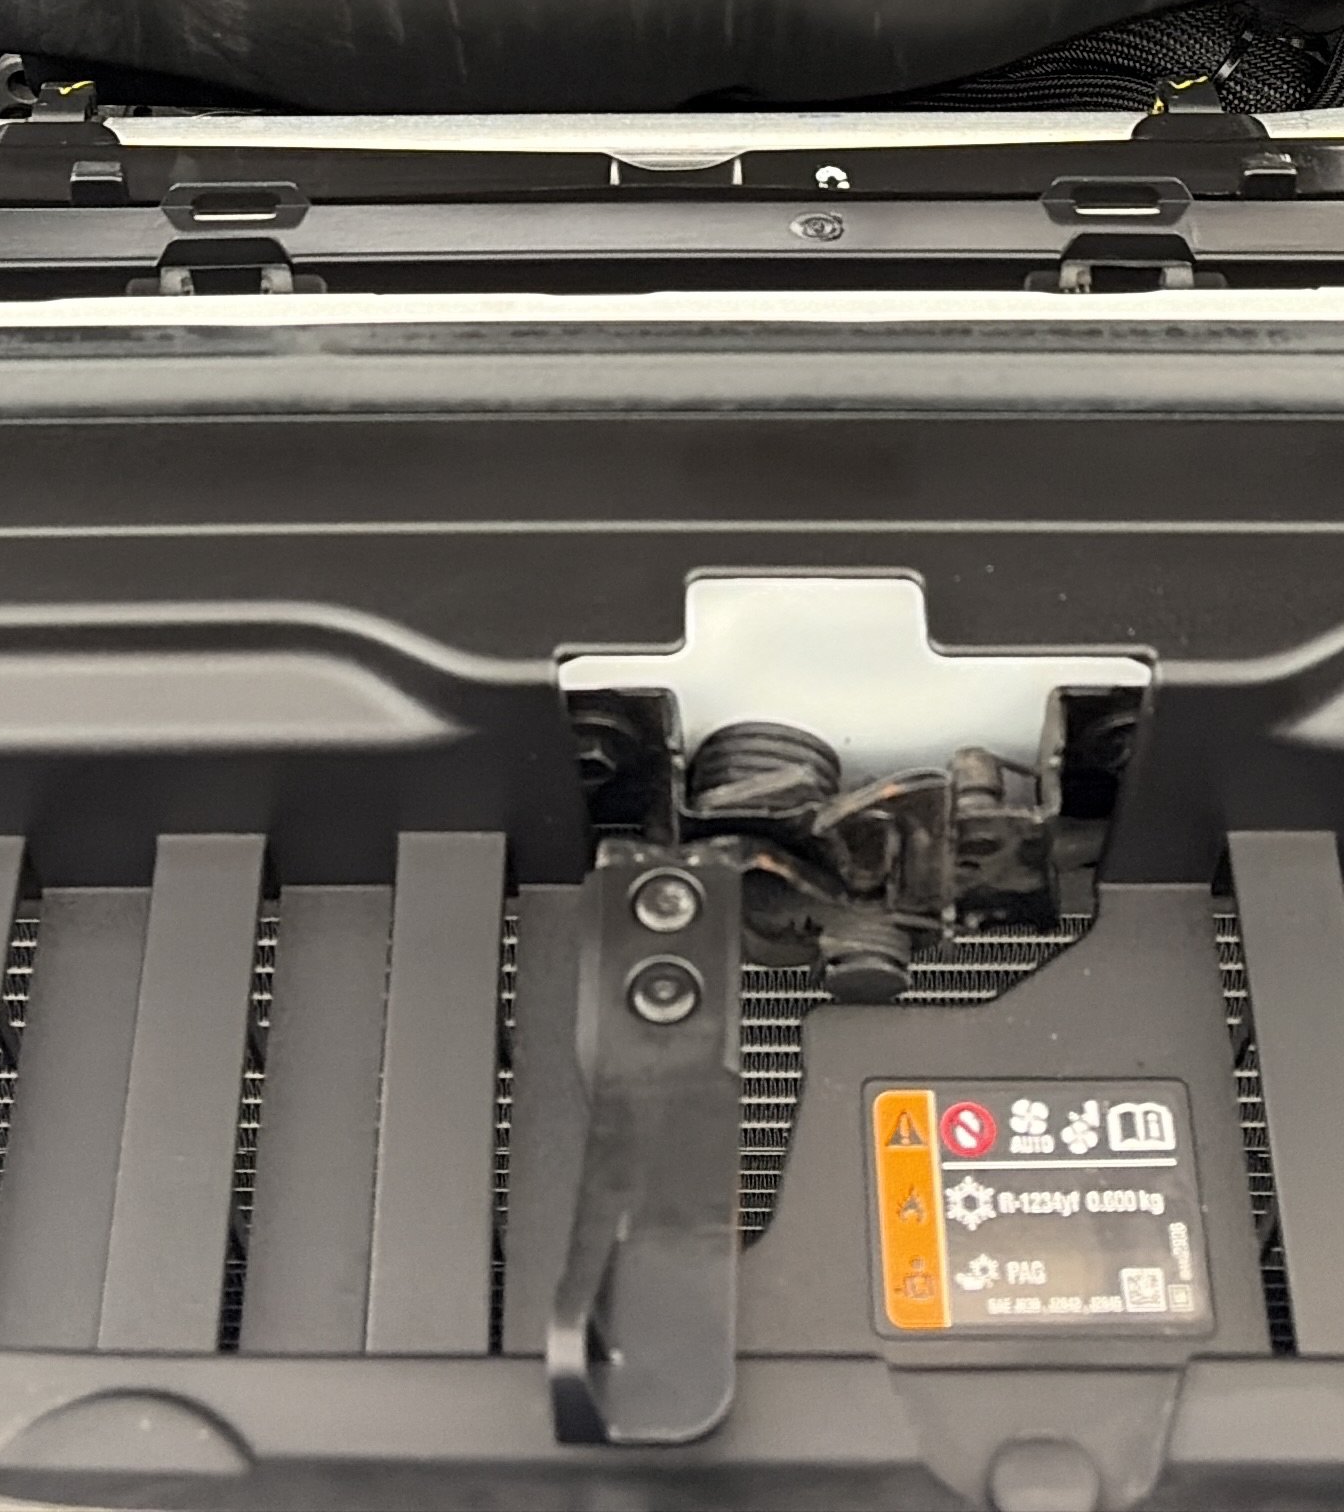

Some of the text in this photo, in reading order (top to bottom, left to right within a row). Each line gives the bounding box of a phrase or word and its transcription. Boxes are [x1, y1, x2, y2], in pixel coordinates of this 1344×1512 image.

[1010, 1134, 1055, 1154] AUTO
[997, 1190, 1080, 1216] R-1234yf
[1139, 1190, 1164, 1215] kg
[1006, 1260, 1046, 1284] PAG
